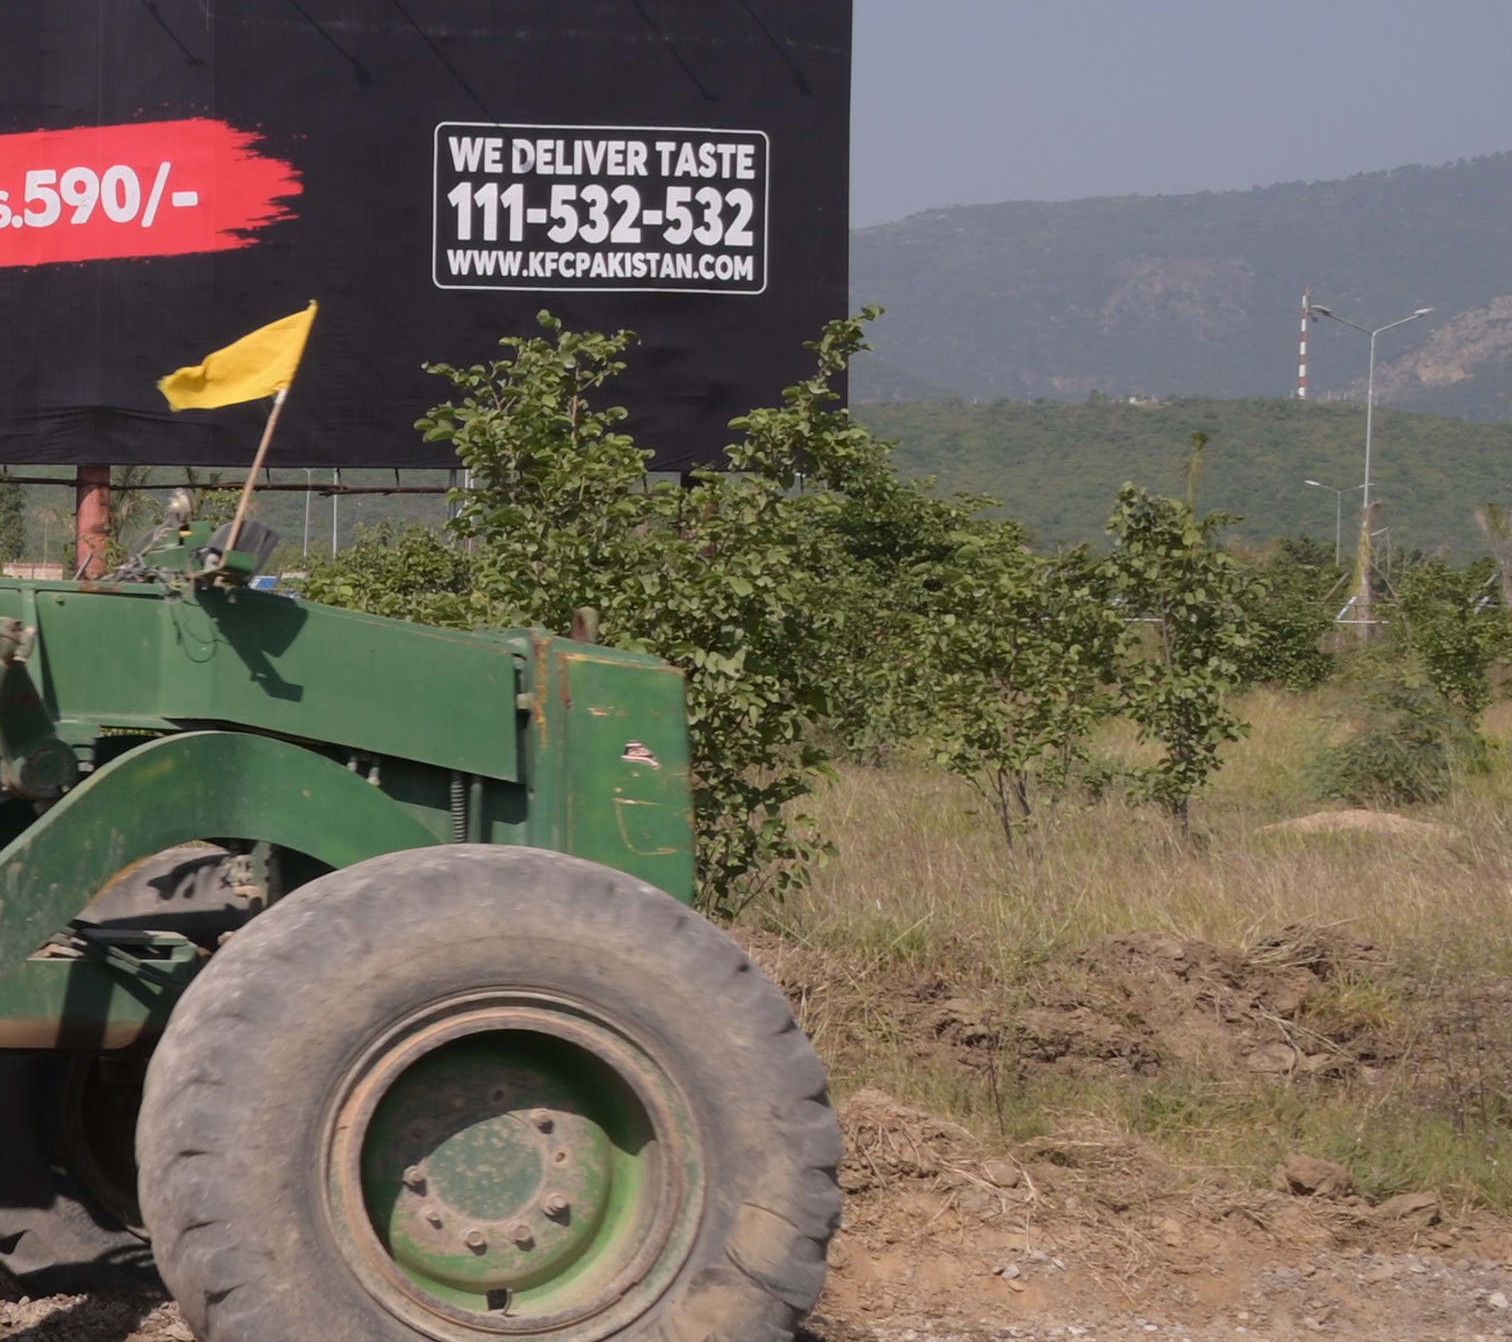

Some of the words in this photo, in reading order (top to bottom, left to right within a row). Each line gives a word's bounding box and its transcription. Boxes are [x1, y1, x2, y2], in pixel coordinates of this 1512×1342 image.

[447, 136, 504, 174] WE
[512, 139, 648, 177] DELIVER
[655, 142, 755, 180] TASTE
[446, 181, 754, 247] 111-532-532
[446, 249, 754, 282] WWW.KFCPAKISTAN.COM
